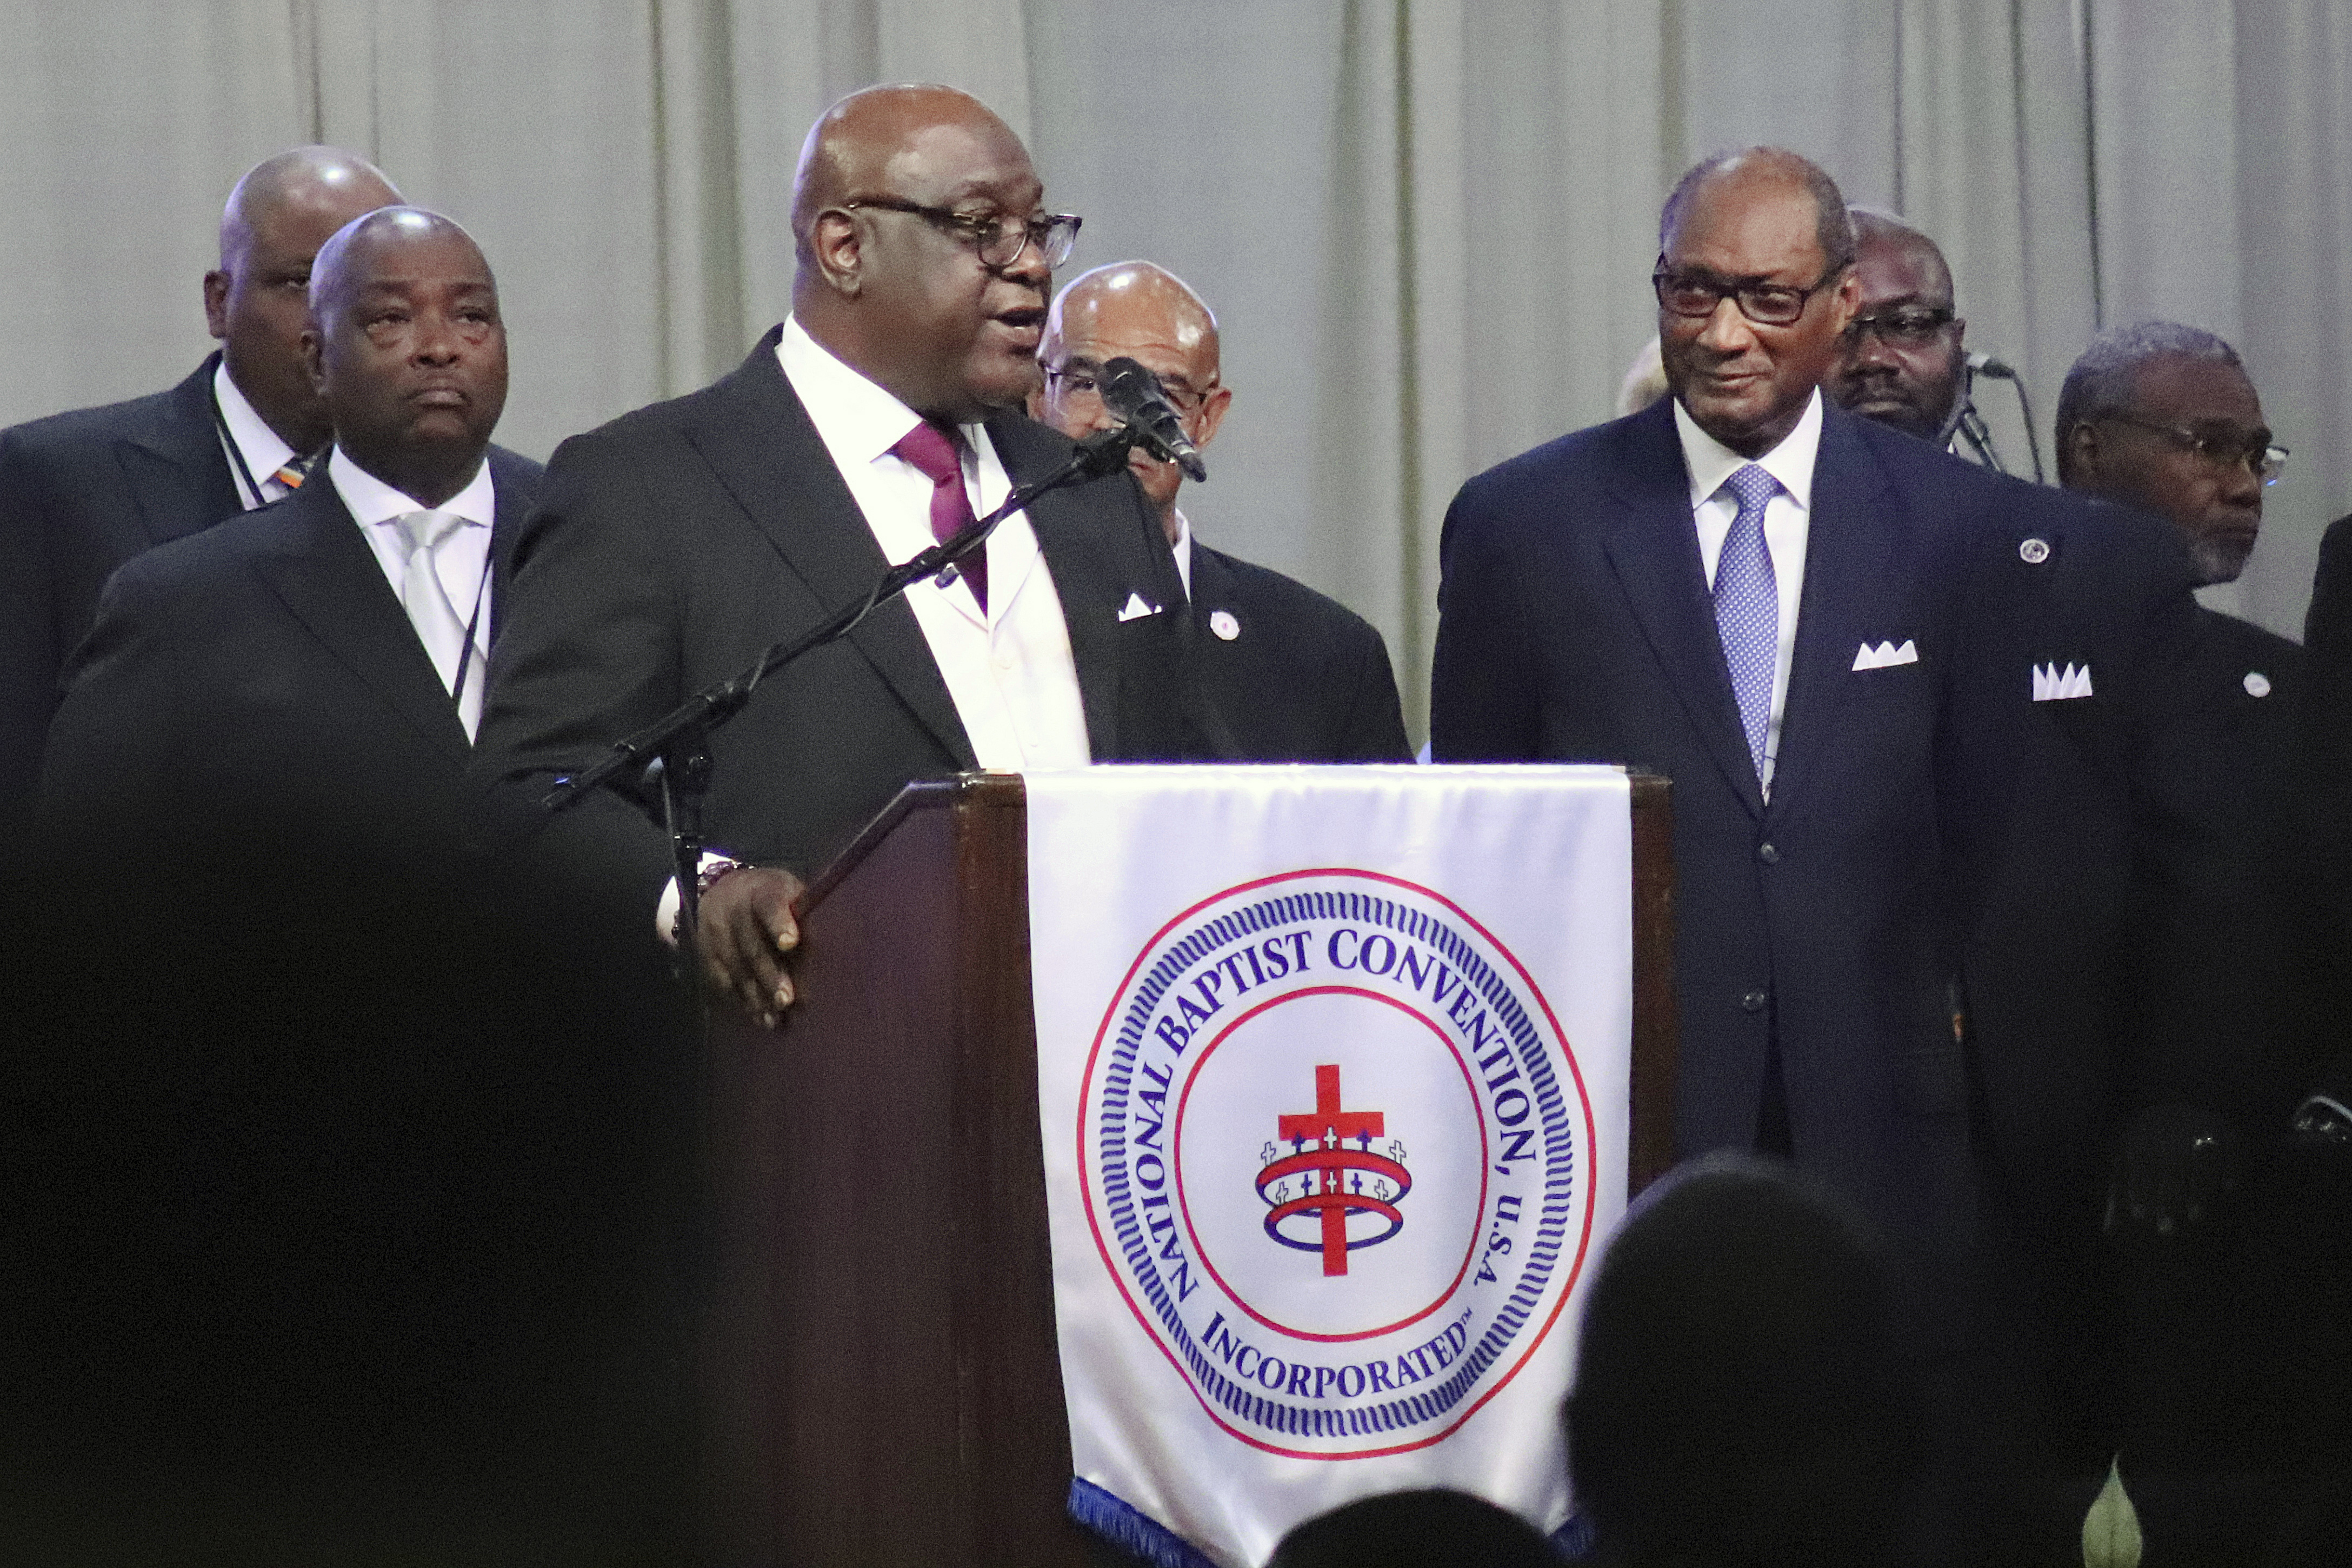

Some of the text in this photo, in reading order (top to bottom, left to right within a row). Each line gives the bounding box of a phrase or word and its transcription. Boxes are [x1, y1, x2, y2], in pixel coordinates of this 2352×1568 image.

[1155, 931, 1312, 1058] BAPTIST
[1328, 929, 1536, 1176] CONVENTION,
[1136, 1063, 1200, 1303] NATIONAL
